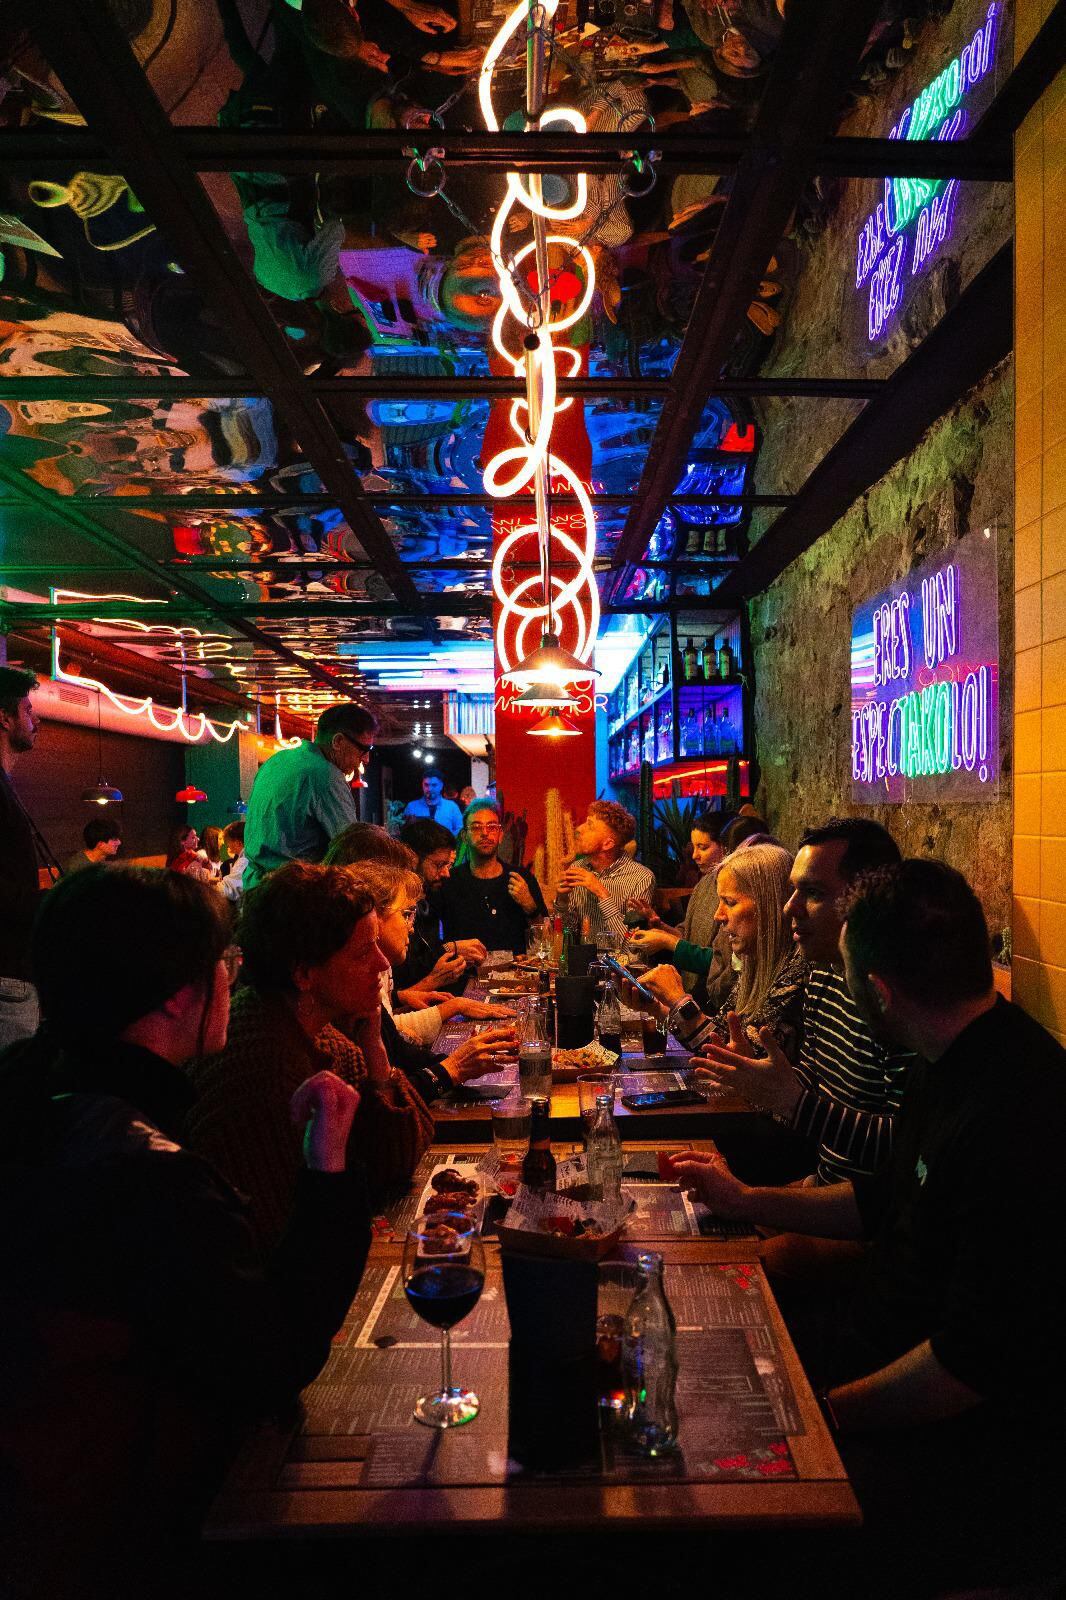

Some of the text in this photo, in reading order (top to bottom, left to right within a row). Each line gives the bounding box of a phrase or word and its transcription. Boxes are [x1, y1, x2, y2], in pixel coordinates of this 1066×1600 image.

[873, 565, 957, 686] ERES UN
[852, 666, 990, 783] ESPECTAKOLO!
